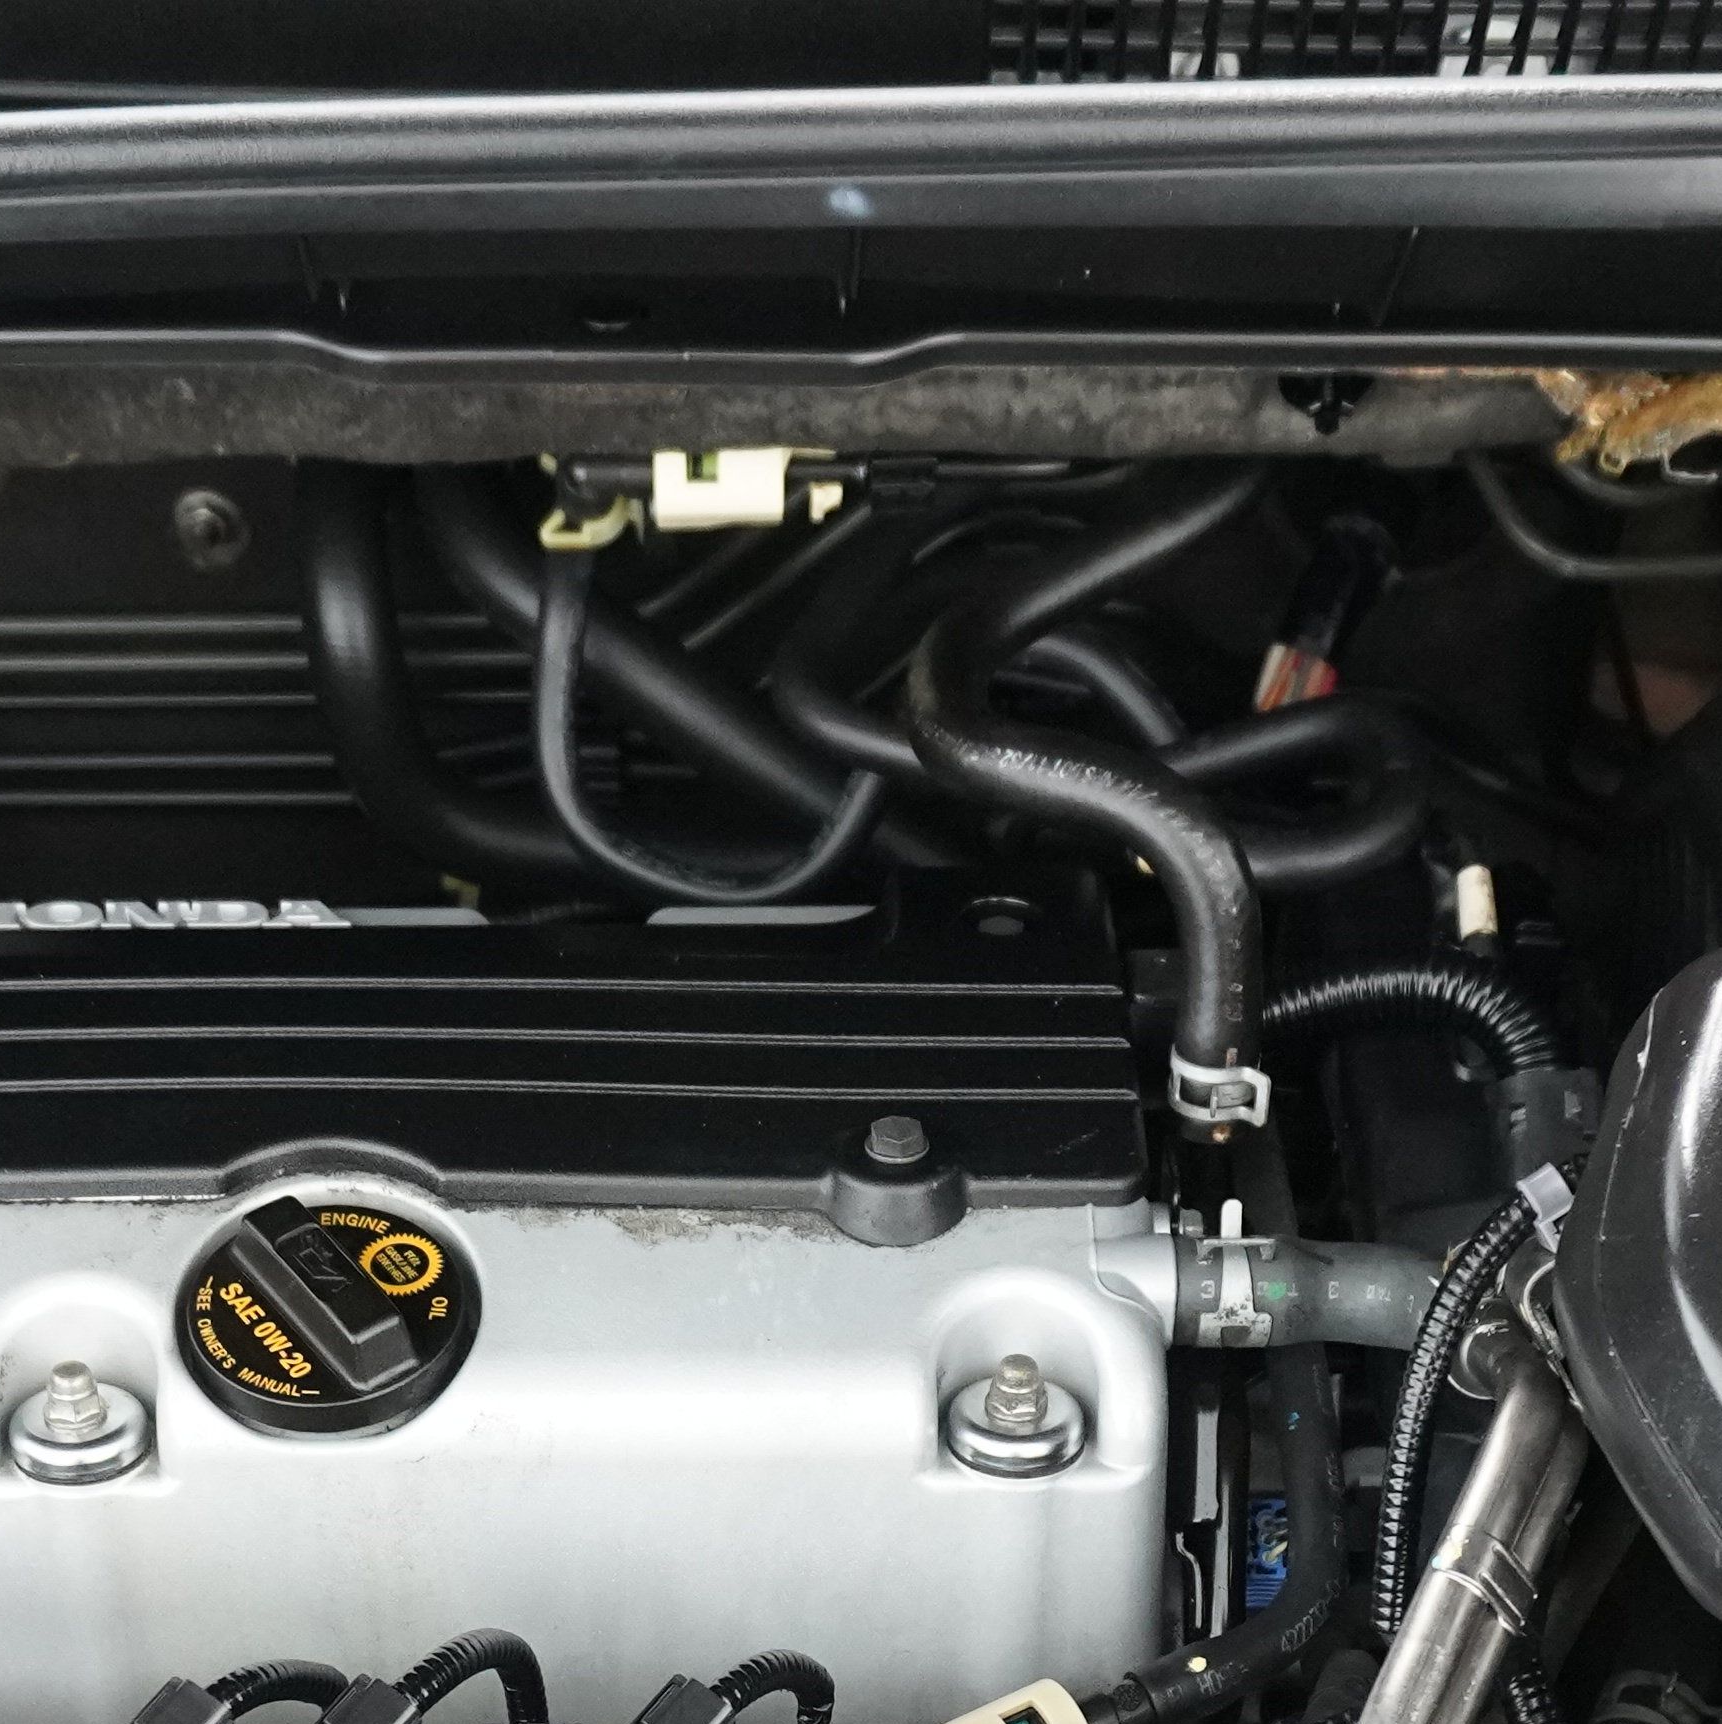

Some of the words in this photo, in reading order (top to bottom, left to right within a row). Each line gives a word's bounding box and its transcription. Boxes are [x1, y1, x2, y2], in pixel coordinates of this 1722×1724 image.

[320, 1213, 391, 1235] ENGINE
[428, 1296, 449, 1320] OIL
[197, 1318, 237, 1370] OWNER'S
[219, 1282, 267, 1326] SAE
[253, 1321, 312, 1379] 0W-20
